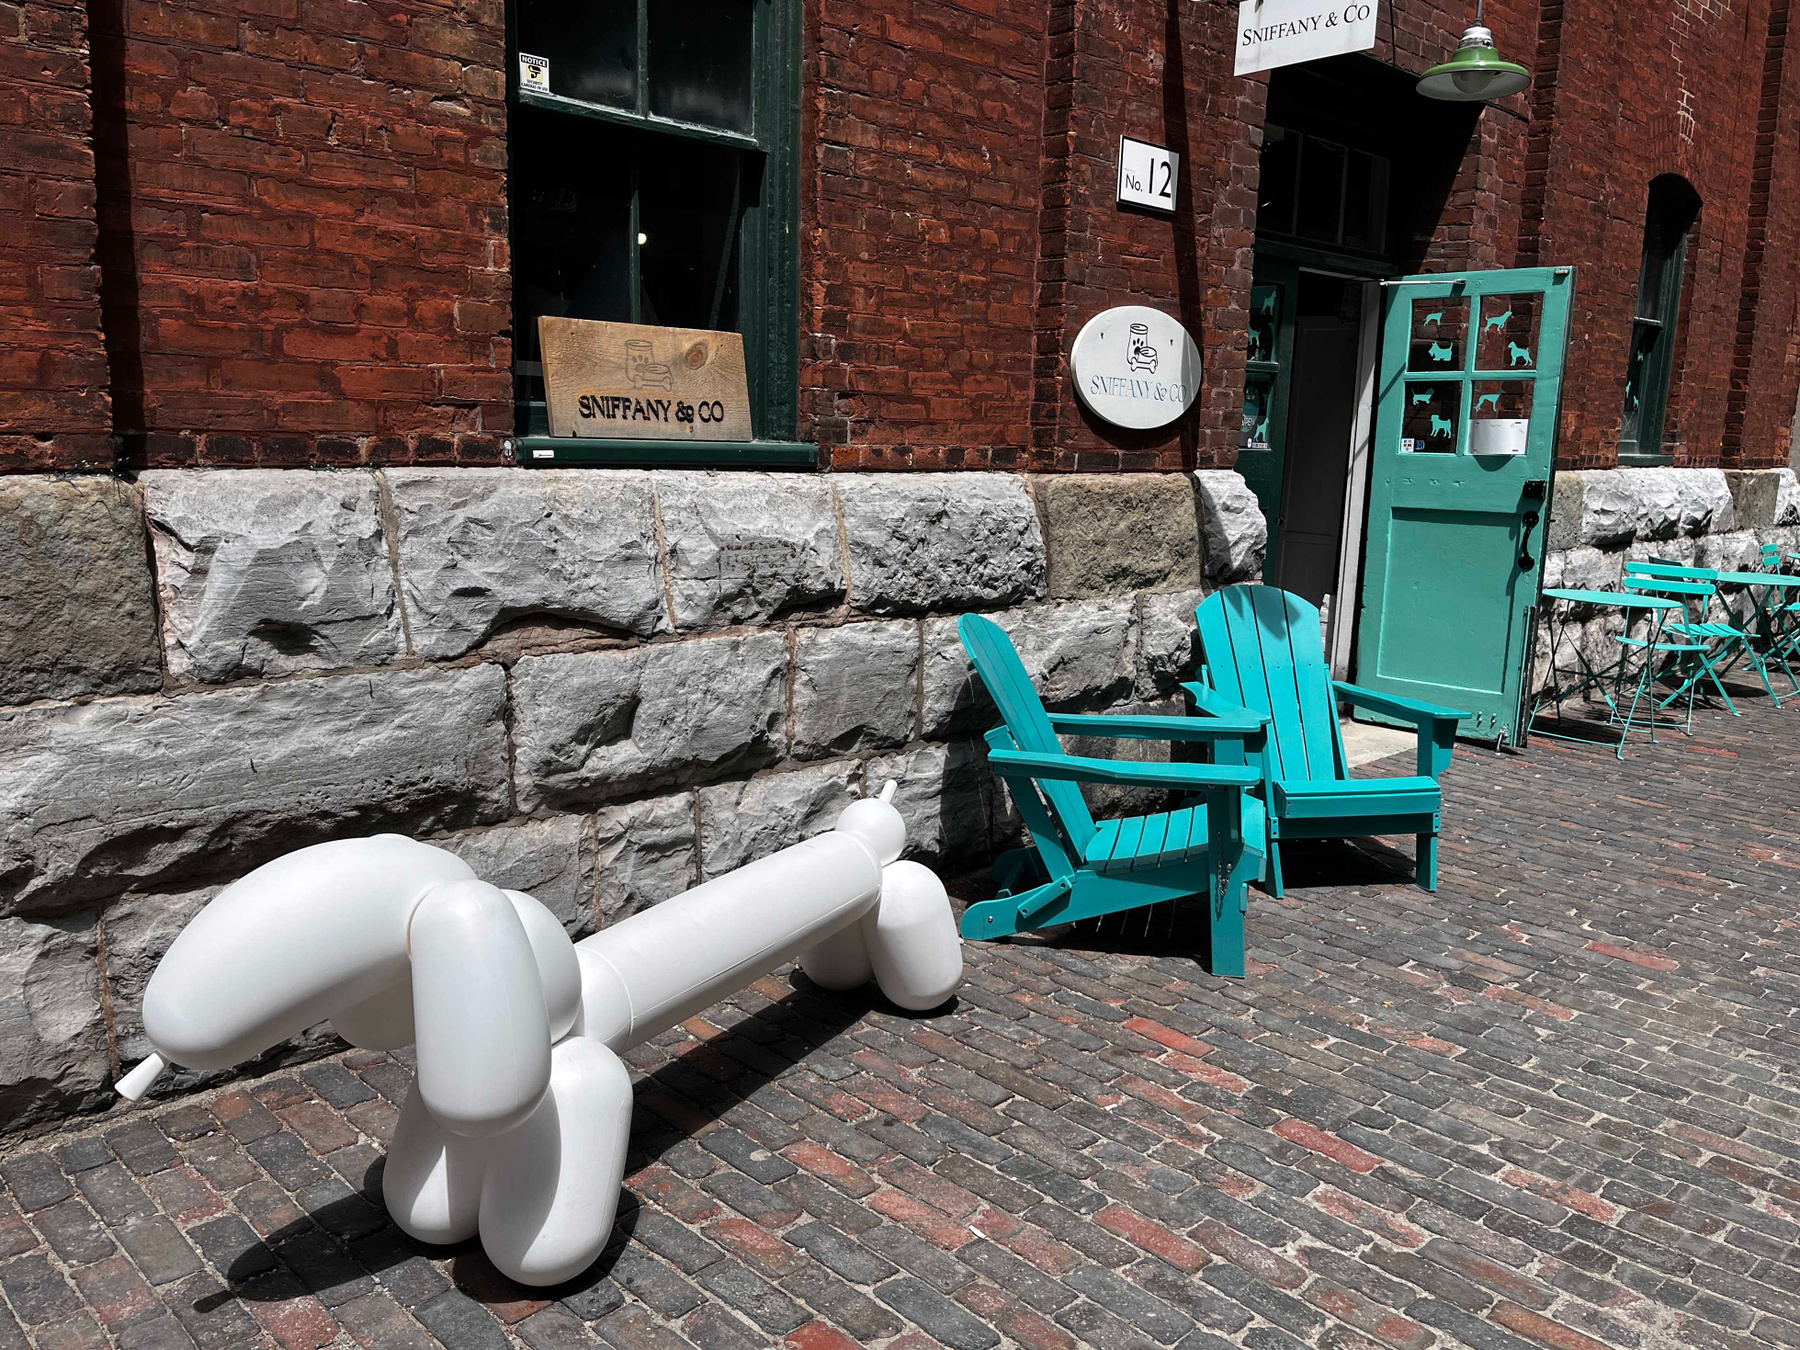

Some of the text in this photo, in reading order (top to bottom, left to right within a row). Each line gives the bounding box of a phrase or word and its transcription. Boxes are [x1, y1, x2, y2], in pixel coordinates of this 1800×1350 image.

[1242, 15, 1322, 46] SNIFFANY
[1325, 12, 1338, 28] &
[522, 55, 547, 67] NOTICE
[1125, 157, 1172, 199] No. 12
[1090, 374, 1187, 403] SNIFFANY & CO
[578, 394, 725, 423] SNIFFANY & CO
